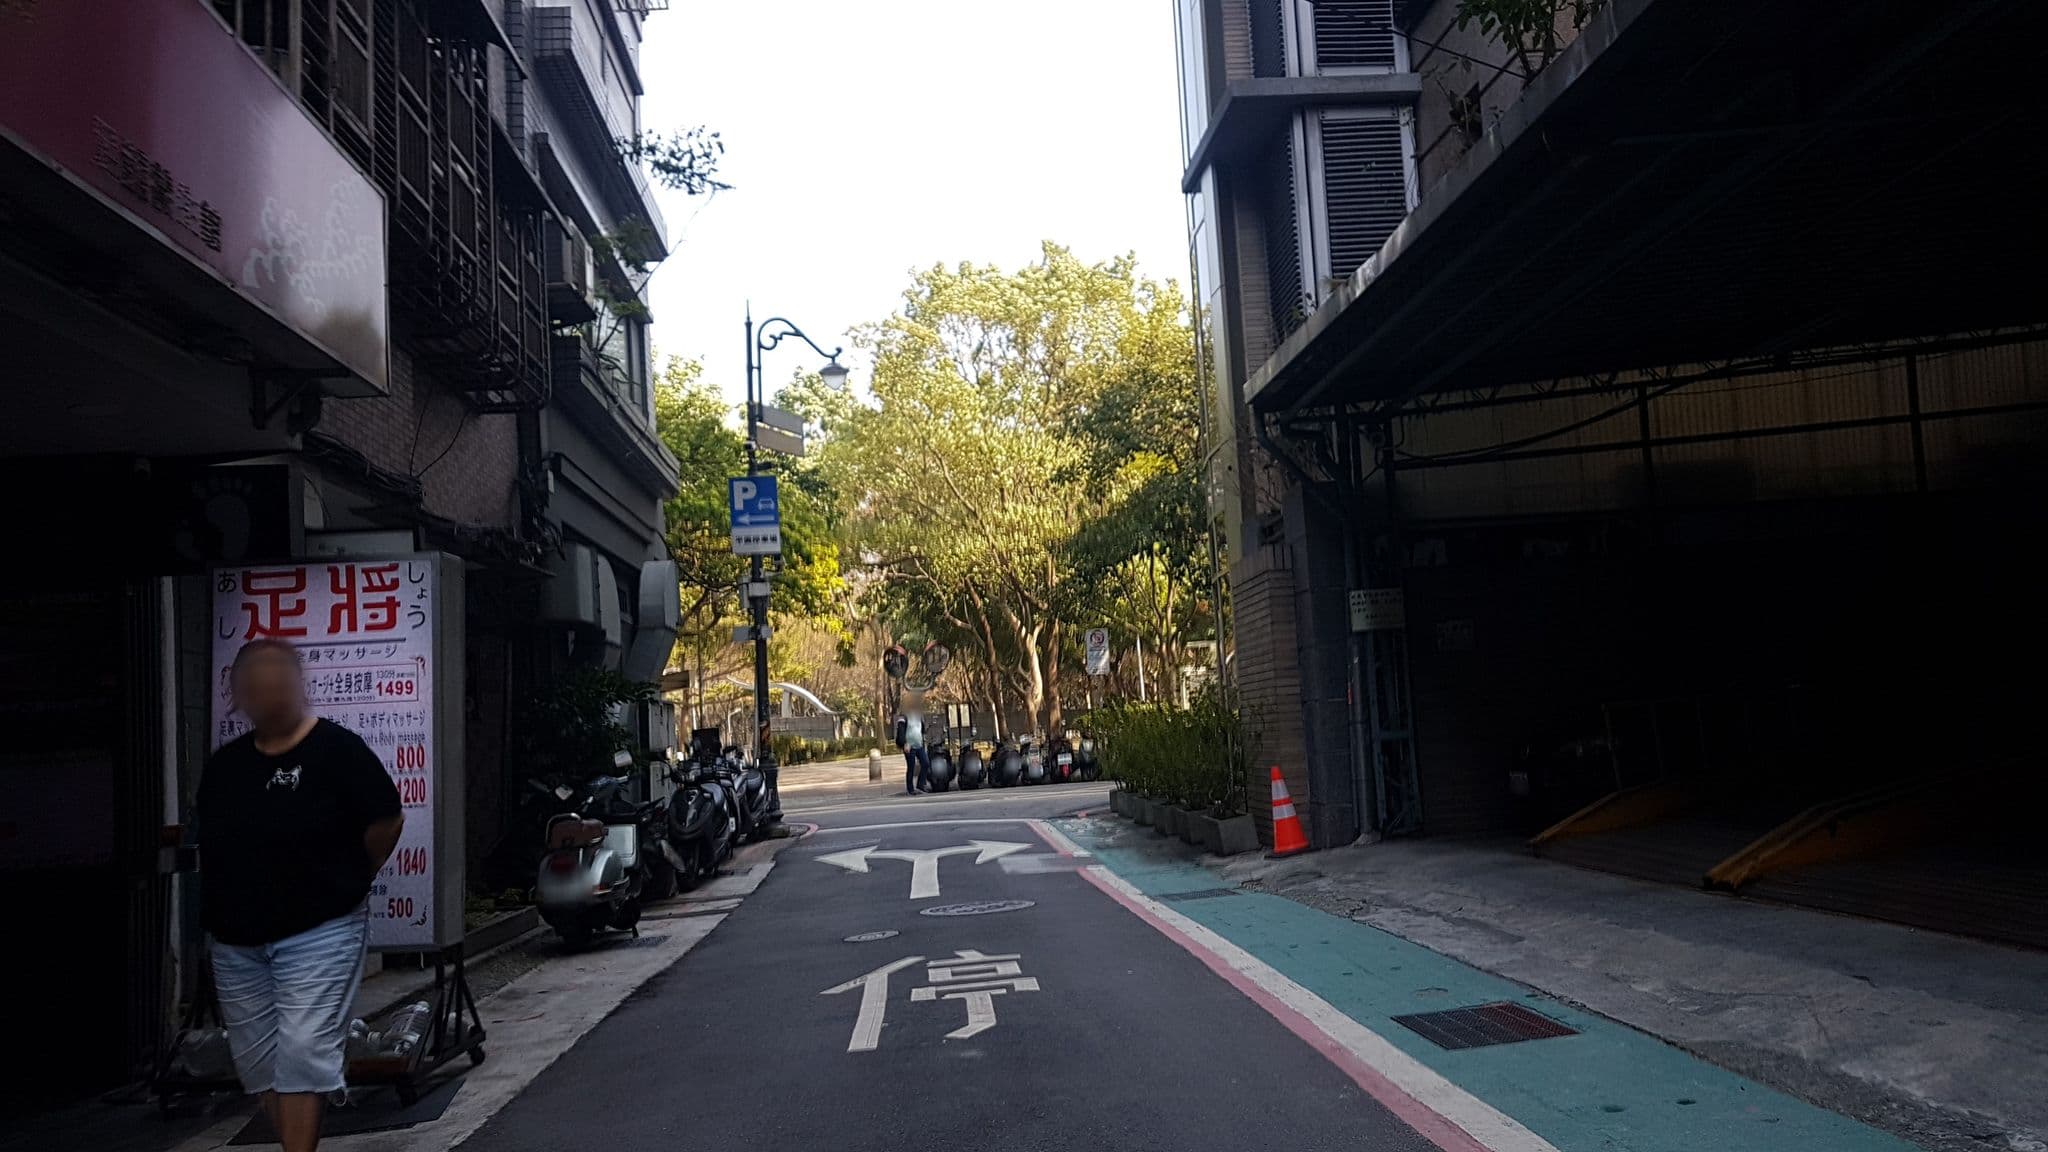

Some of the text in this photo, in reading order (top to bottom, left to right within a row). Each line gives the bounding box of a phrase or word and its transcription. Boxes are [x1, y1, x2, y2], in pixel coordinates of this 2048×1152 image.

[733, 481, 757, 511] P
[217, 571, 237, 639] あし
[241, 563, 401, 640] 足將
[407, 562, 428, 629] しょう
[376, 679, 414, 697] 1499
[397, 745, 425, 769] 800
[397, 777, 426, 804] 1200
[397, 847, 426, 877] 1840
[388, 897, 413, 919] 500
[819, 950, 1050, 1052] 停
